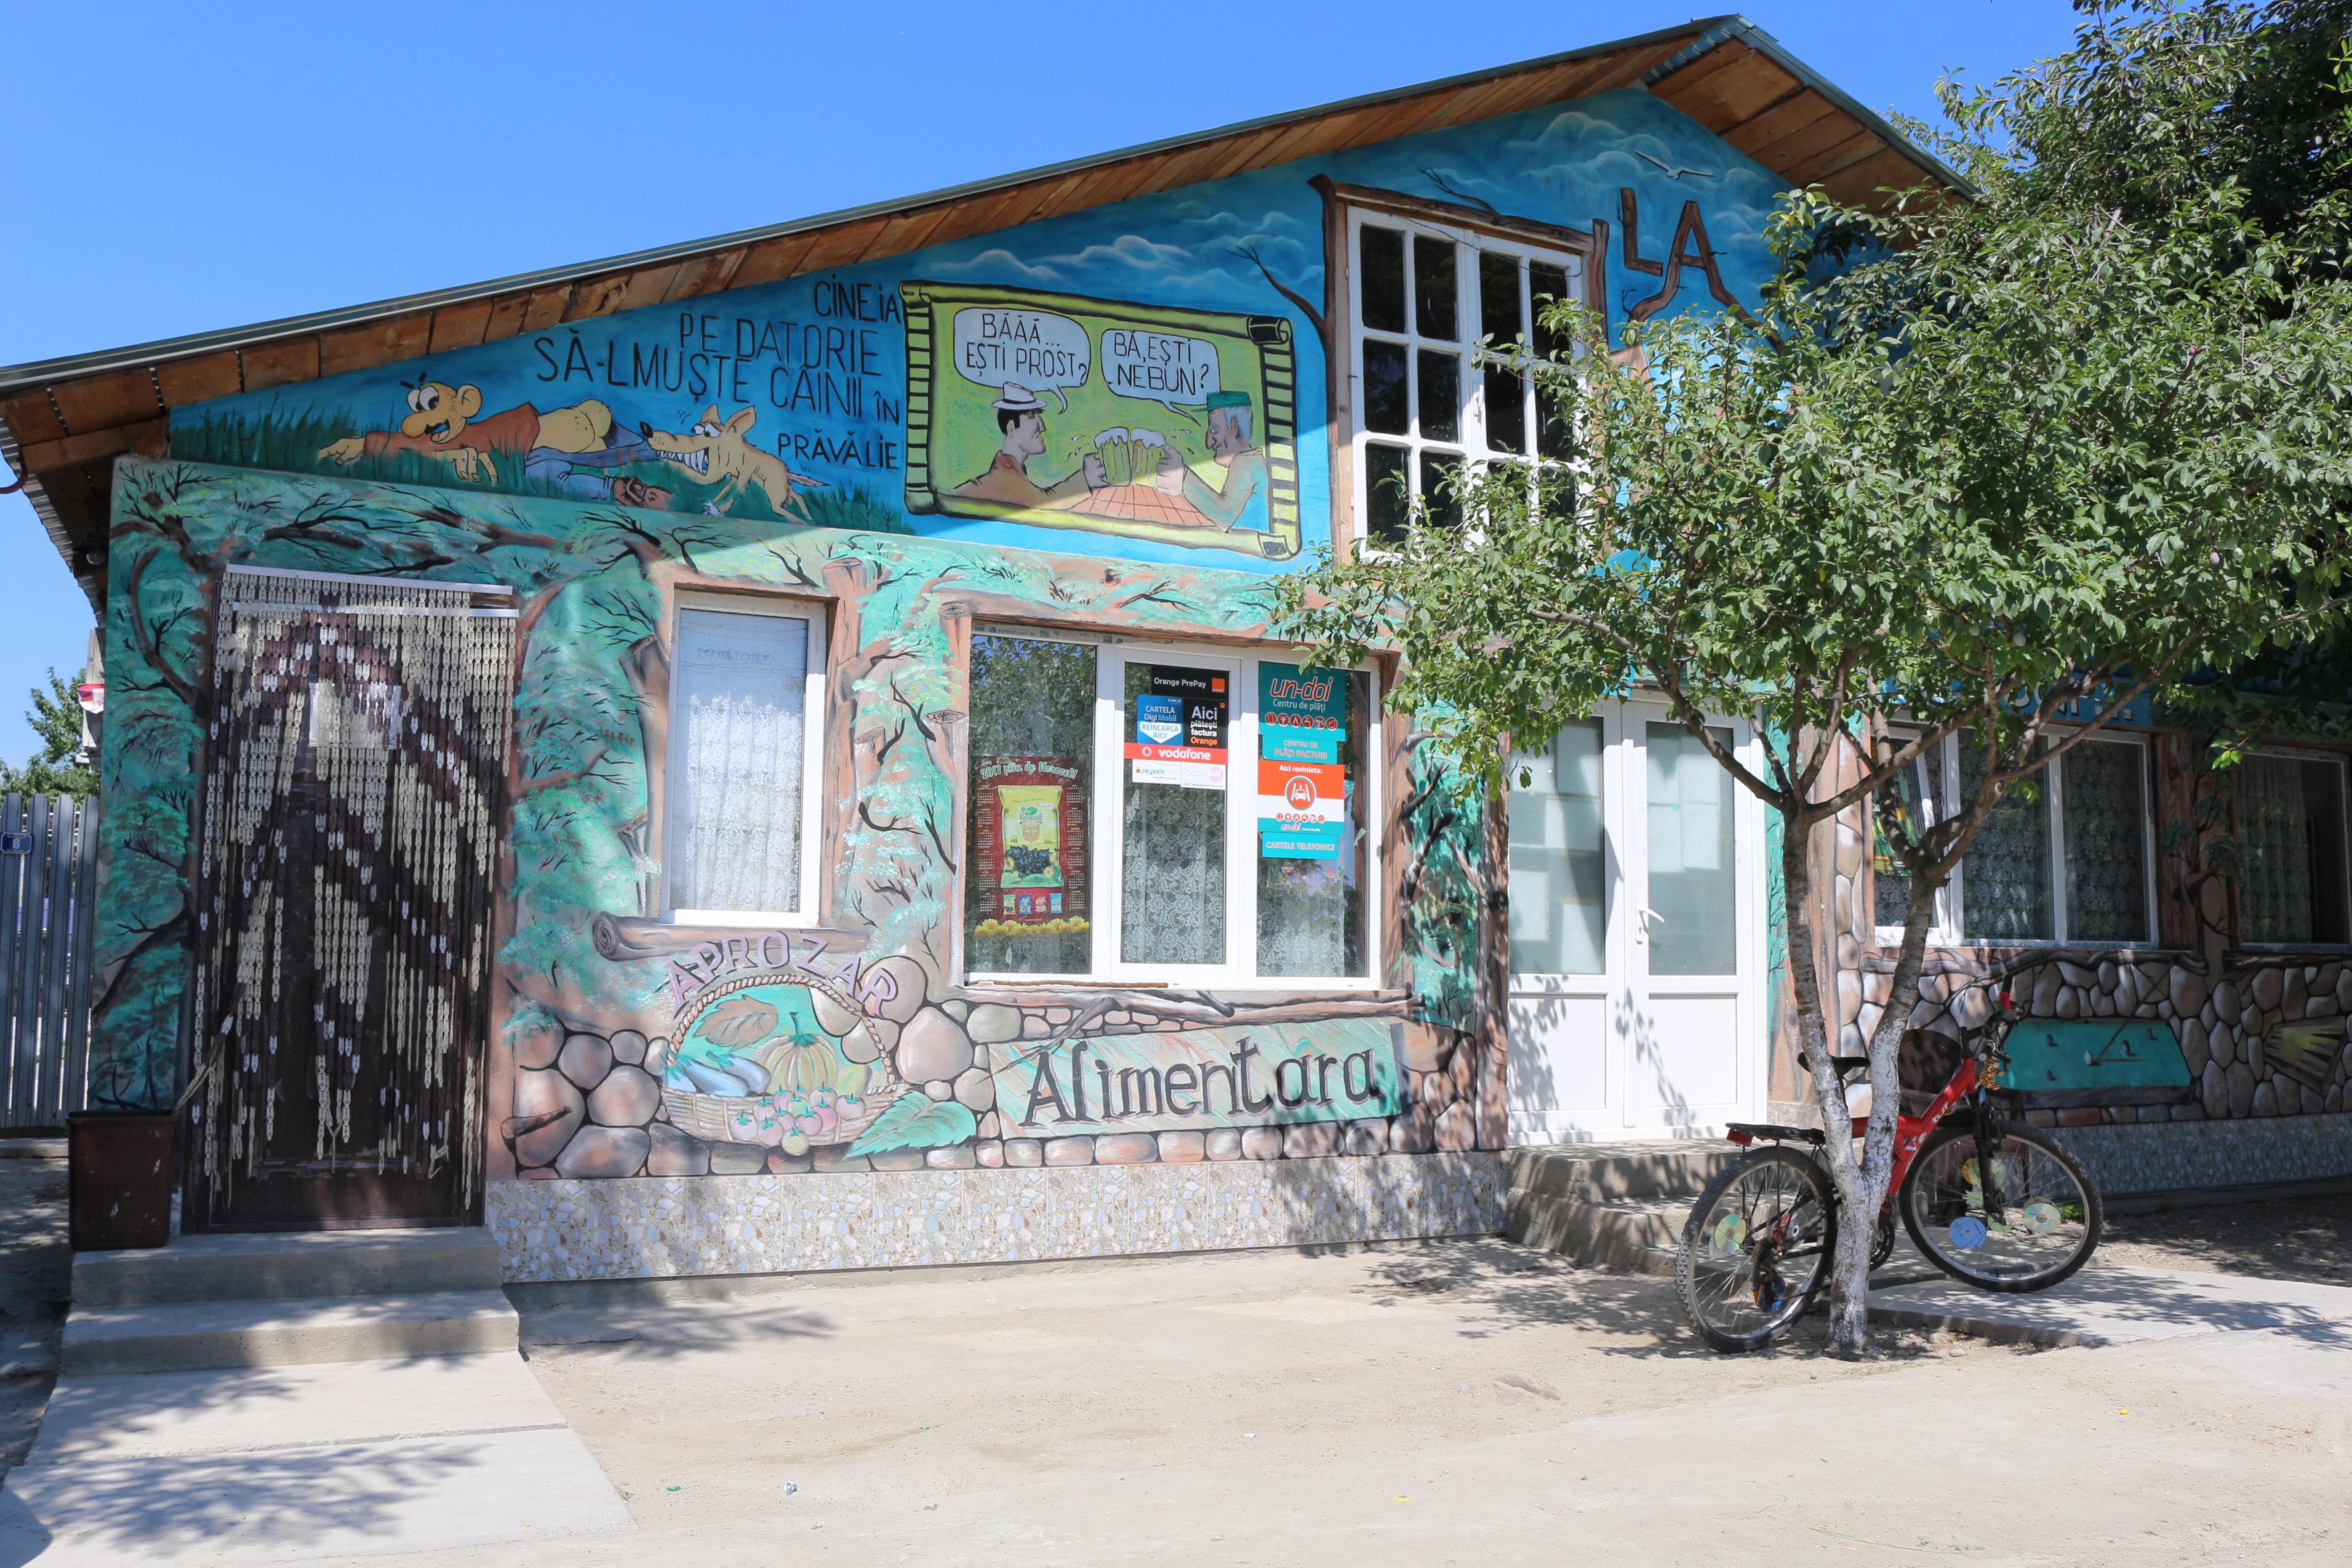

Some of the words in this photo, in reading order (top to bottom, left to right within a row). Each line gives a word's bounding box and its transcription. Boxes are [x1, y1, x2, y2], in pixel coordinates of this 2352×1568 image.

[681, 313, 719, 353] PE
[736, 318, 882, 376] DATORIE
[1016, 348, 1087, 386] PROST?
[534, 328, 628, 386] SĂ-L
[770, 364, 861, 418] CÂINII
[874, 391, 899, 426] ÎN
[1117, 363, 1209, 395] NEBUN?
[1154, 677, 1180, 686] Orange
[1181, 680, 1206, 689] PrePay
[1270, 676, 1333, 701] un-doi
[1146, 706, 1175, 714] CARTELA
[1273, 699, 1297, 708] Centru
[1299, 701, 1308, 709] de
[1144, 713, 1157, 722] Digi
[1191, 706, 1217, 720] Aici
[1191, 729, 1217, 737] factura
[1191, 737, 1217, 746] Orange
[1158, 748, 1211, 760] vodafone
[1296, 750, 1327, 759] FACTURI
[980, 764, 1001, 779] 2017
[1003, 761, 1023, 776] plin
[1024, 761, 1036, 773] de
[1039, 761, 1078, 779] Norocel!
[1183, 767, 1207, 777] focus
[1281, 823, 1301, 831] un-doi
[13, 838, 20, 849] 8
[1296, 843, 1335, 851] TELEFONICE
[664, 931, 898, 1018] APROZAR
[1018, 1035, 1387, 1129] Alimentara
